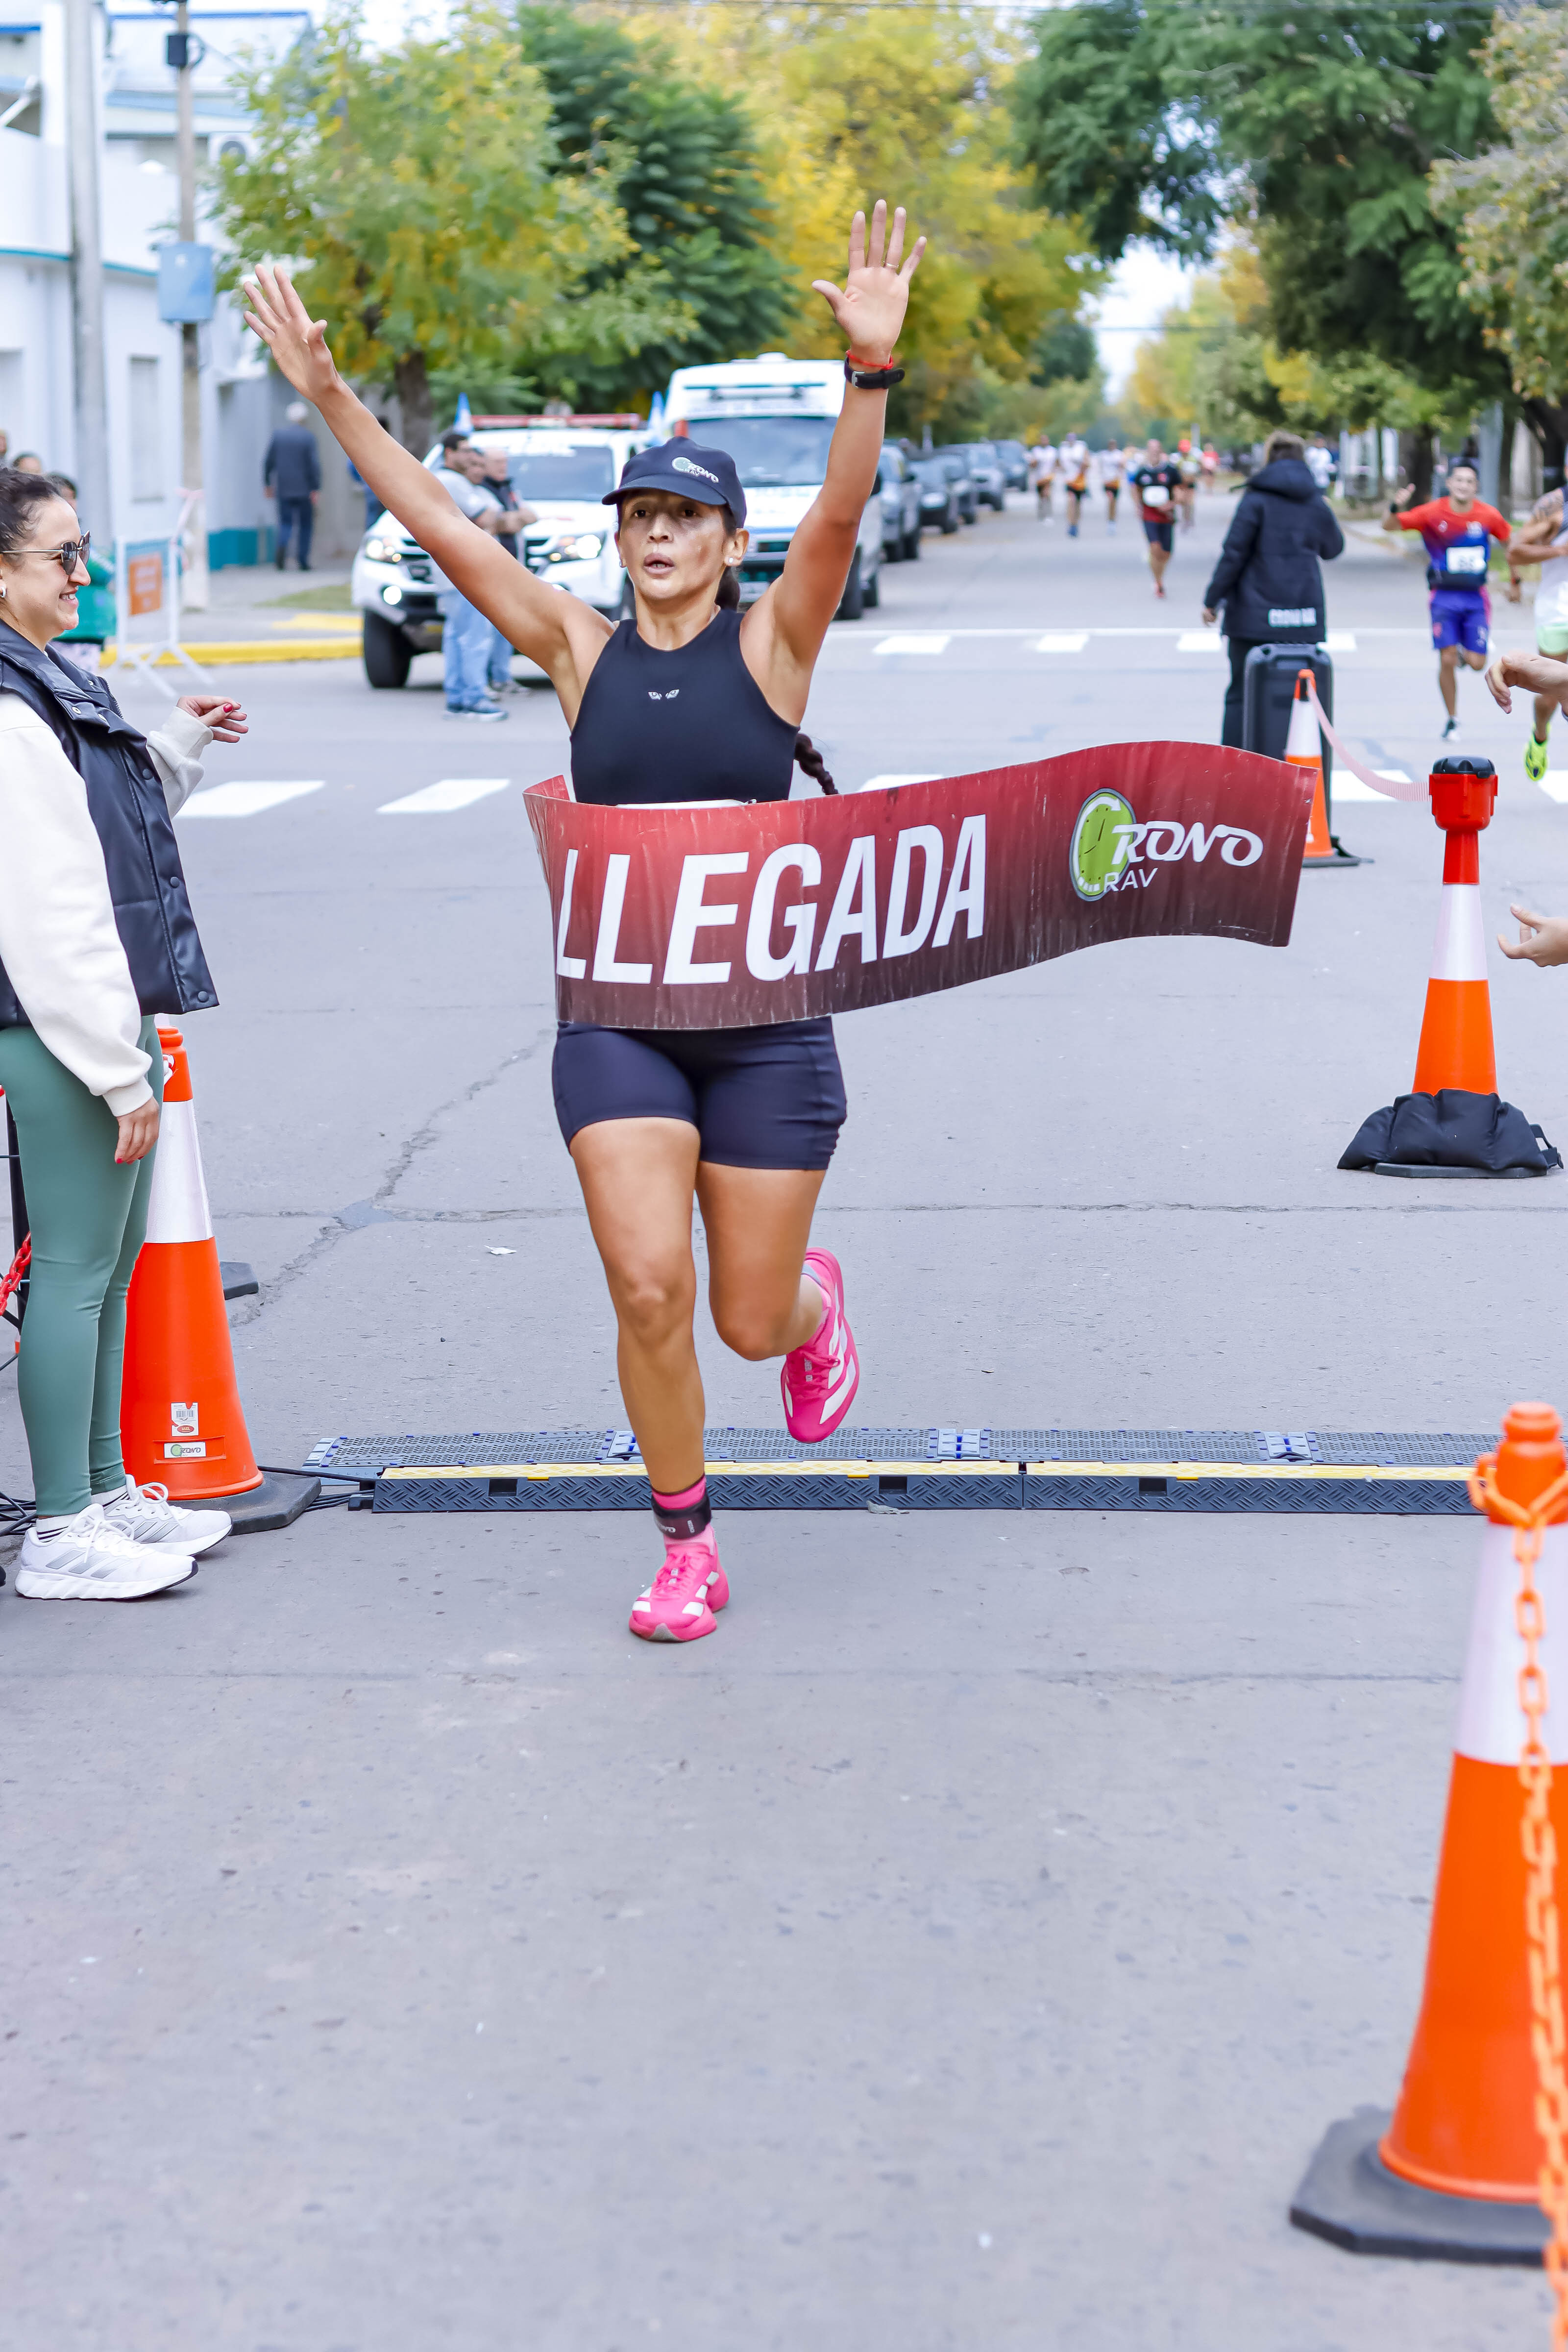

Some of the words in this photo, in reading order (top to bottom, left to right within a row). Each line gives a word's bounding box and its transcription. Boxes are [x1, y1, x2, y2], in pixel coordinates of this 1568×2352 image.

[671, 457, 719, 483] CRONO
[1070, 789, 1264, 897] CRONO
[556, 814, 986, 985] LLEGADA
[1103, 867, 1158, 892] RAV
